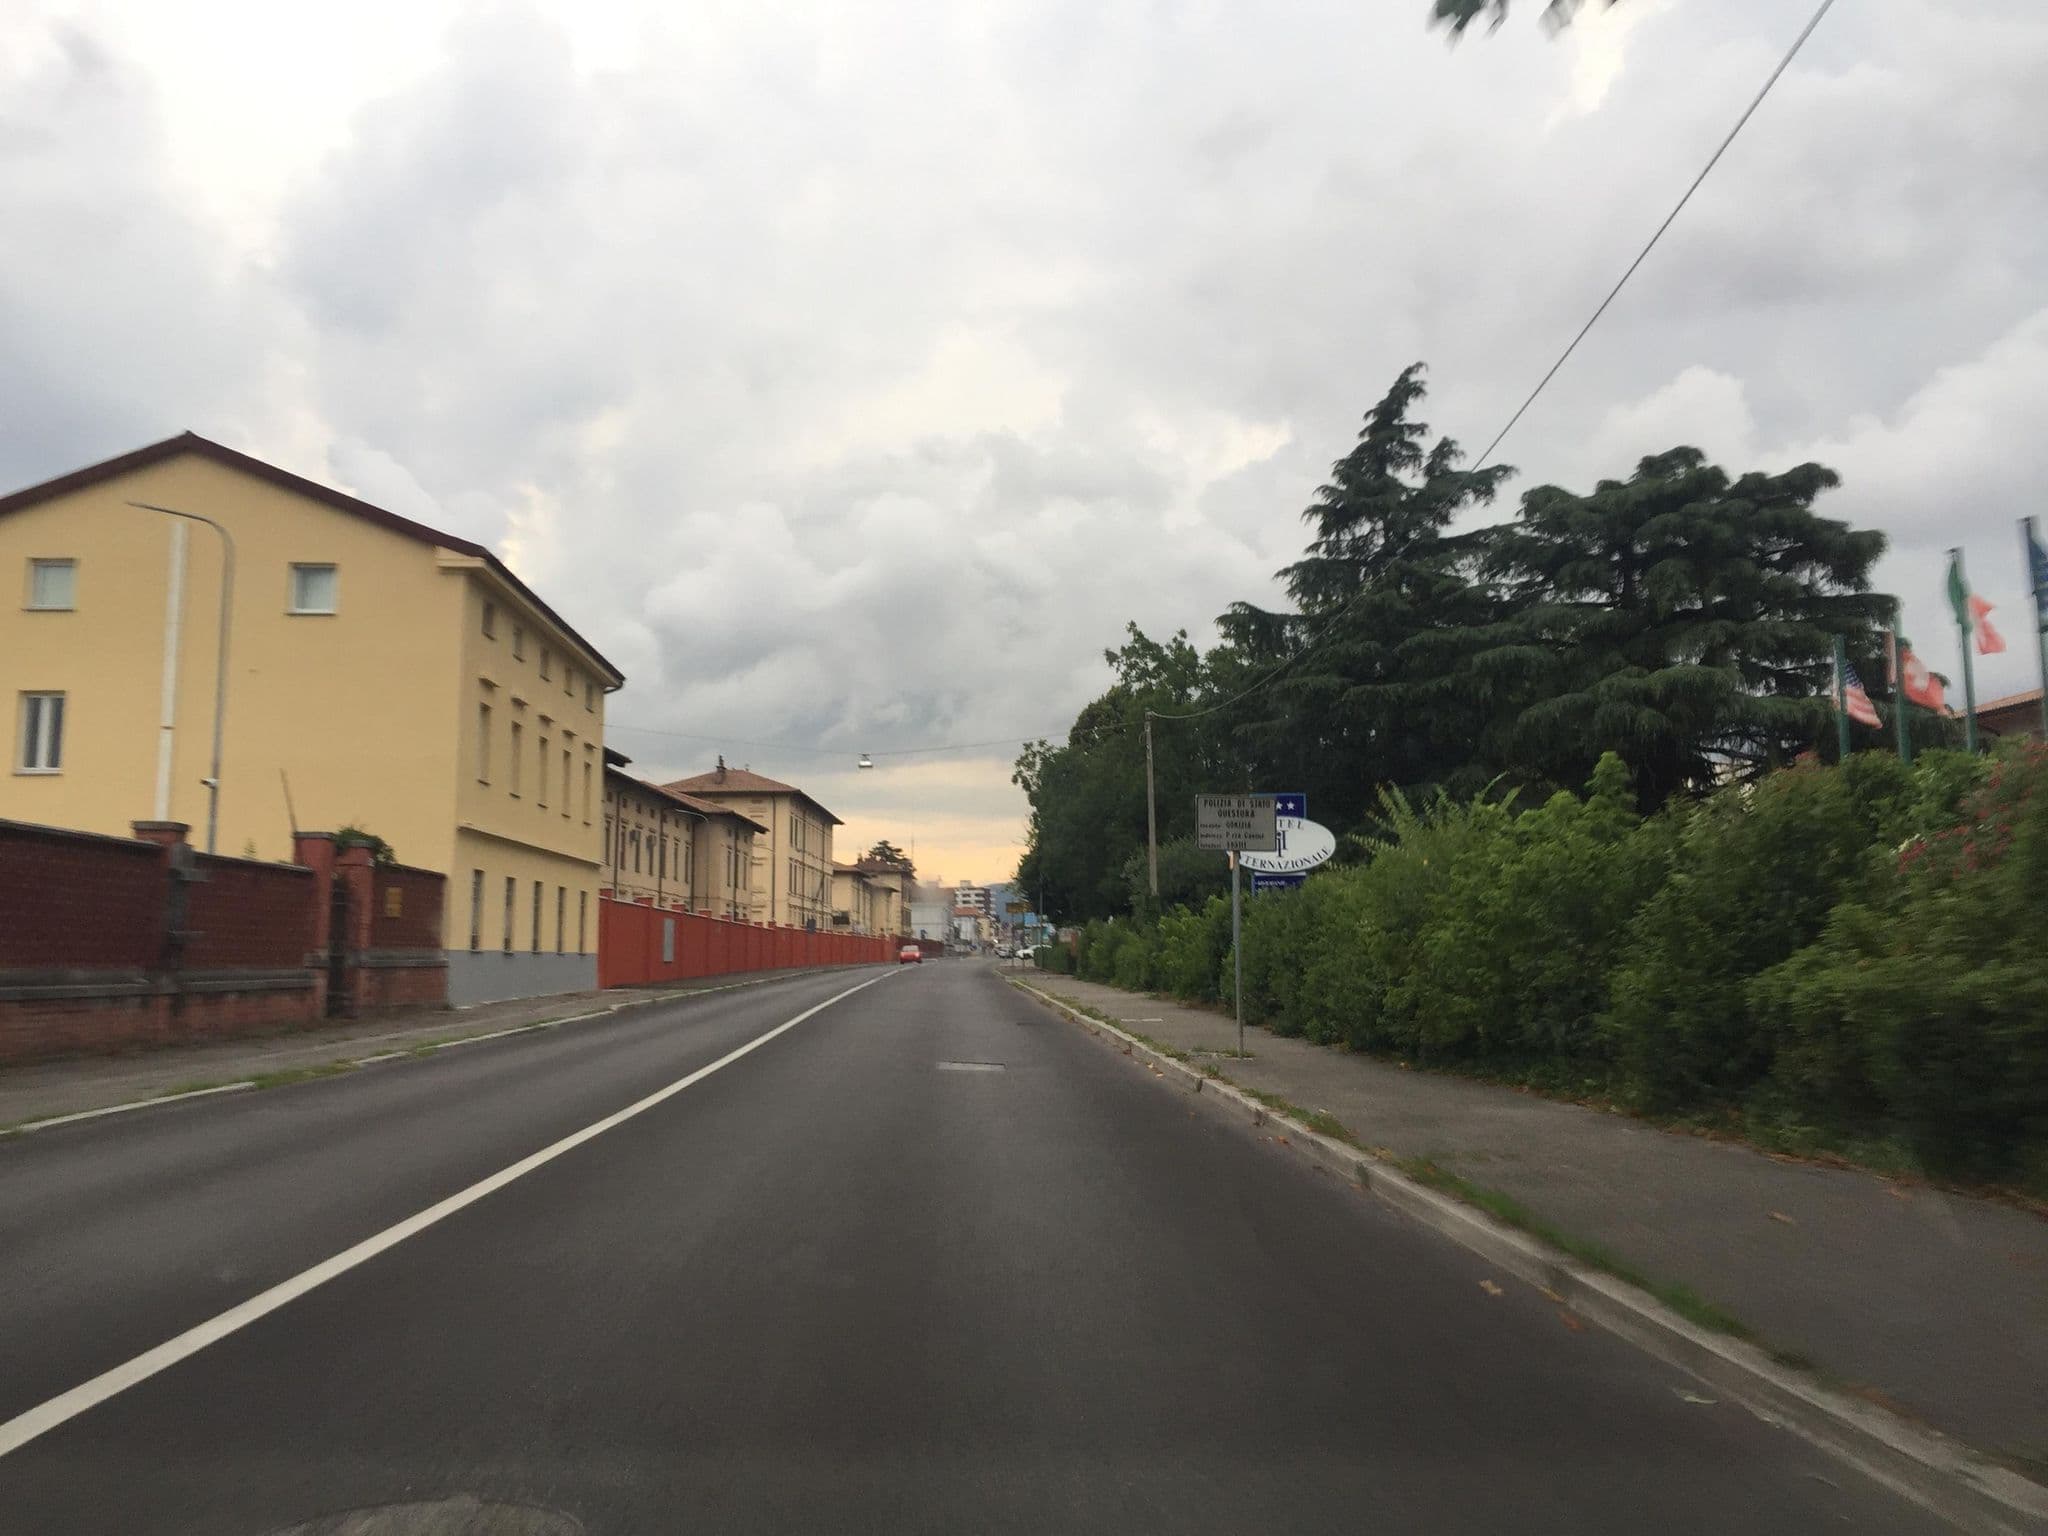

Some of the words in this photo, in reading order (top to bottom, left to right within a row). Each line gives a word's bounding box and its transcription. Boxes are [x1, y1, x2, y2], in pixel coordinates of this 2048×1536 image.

[1204, 799, 1231, 808] POLIZIA
[1237, 799, 1245, 808] DI
[1250, 799, 1271, 808] STATO
[1217, 809, 1255, 818] QUESTURA
[1279, 819, 1304, 831] TEL
[1243, 846, 1332, 870] TERNAZIONALE
